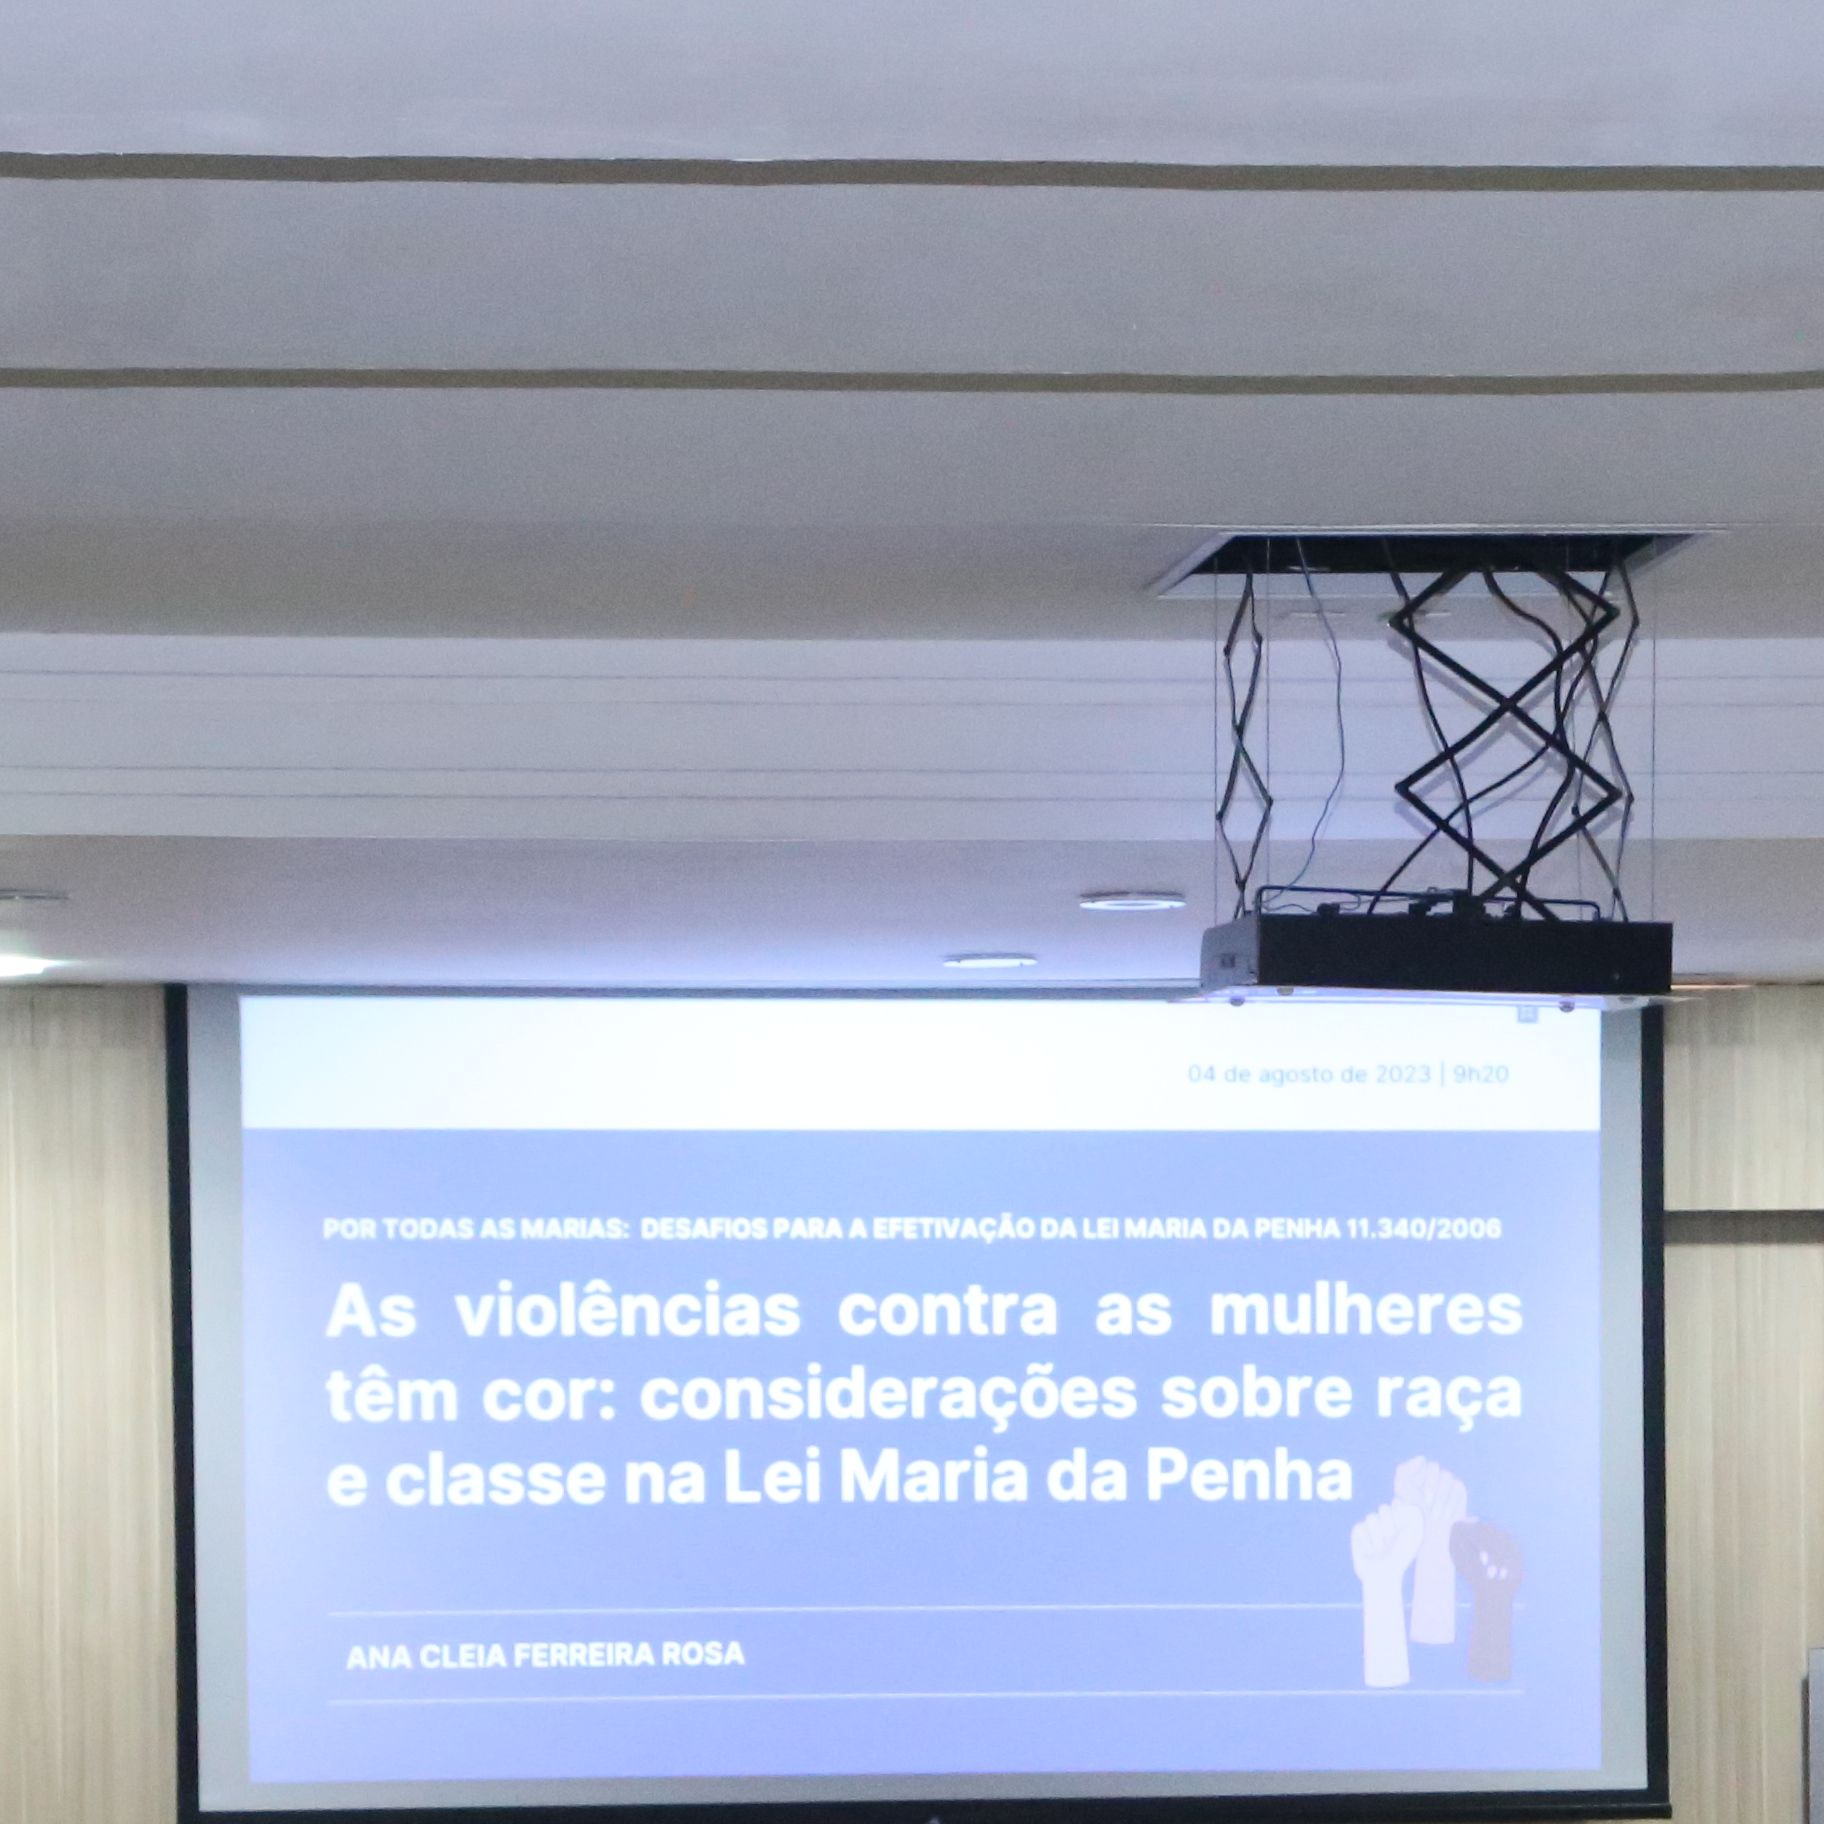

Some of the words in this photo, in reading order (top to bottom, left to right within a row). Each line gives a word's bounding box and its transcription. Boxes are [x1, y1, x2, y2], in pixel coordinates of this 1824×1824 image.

[1188, 1064, 1216, 1084] 04
[1223, 1064, 1251, 1084] de
[1259, 1066, 1334, 1088] agosto
[1340, 1064, 1368, 1084] de
[1376, 1064, 1431, 1084] 2023
[1453, 1064, 1510, 1084] 9h20
[322, 1217, 376, 1240] POR
[382, 1217, 474, 1240] TODAS
[480, 1217, 516, 1240] AS
[521, 1217, 630, 1240] MARIAS:
[641, 1217, 768, 1240] DESAFIOS
[774, 1217, 843, 1240] PARA
[849, 1217, 868, 1240] A
[873, 1213, 1036, 1244] EFETIVAÇÃO
[1041, 1217, 1077, 1240] DA
[1083, 1217, 1119, 1240] LEI
[1124, 1217, 1207, 1240] MARIA
[1213, 1217, 1249, 1240] DA
[1255, 1217, 1340, 1240] PENHA
[1347, 1217, 1502, 1242] 11.340/2006
[326, 1283, 417, 1338] As
[455, 1279, 801, 1338] violências
[838, 1284, 1057, 1337] contra
[1095, 1293, 1172, 1336] as
[1211, 1281, 1523, 1336] mulheres
[325, 1364, 458, 1422] têm
[482, 1375, 616, 1421] cor:
[640, 1363, 1137, 1434] considerações
[1161, 1365, 1353, 1419] sobre
[1376, 1374, 1522, 1432] raça
[327, 1462, 367, 1506] e
[386, 1451, 606, 1506] classe
[625, 1457, 705, 1504] na
[724, 1446, 821, 1504] Lei
[840, 1445, 1028, 1503] Maria
[1046, 1447, 1127, 1502] da
[1146, 1446, 1353, 1501] Penha
[346, 1645, 412, 1670] ANA
[419, 1644, 507, 1669] CLEIA
[514, 1643, 655, 1668] FERREIRA
[662, 1641, 746, 1667] ROSA
